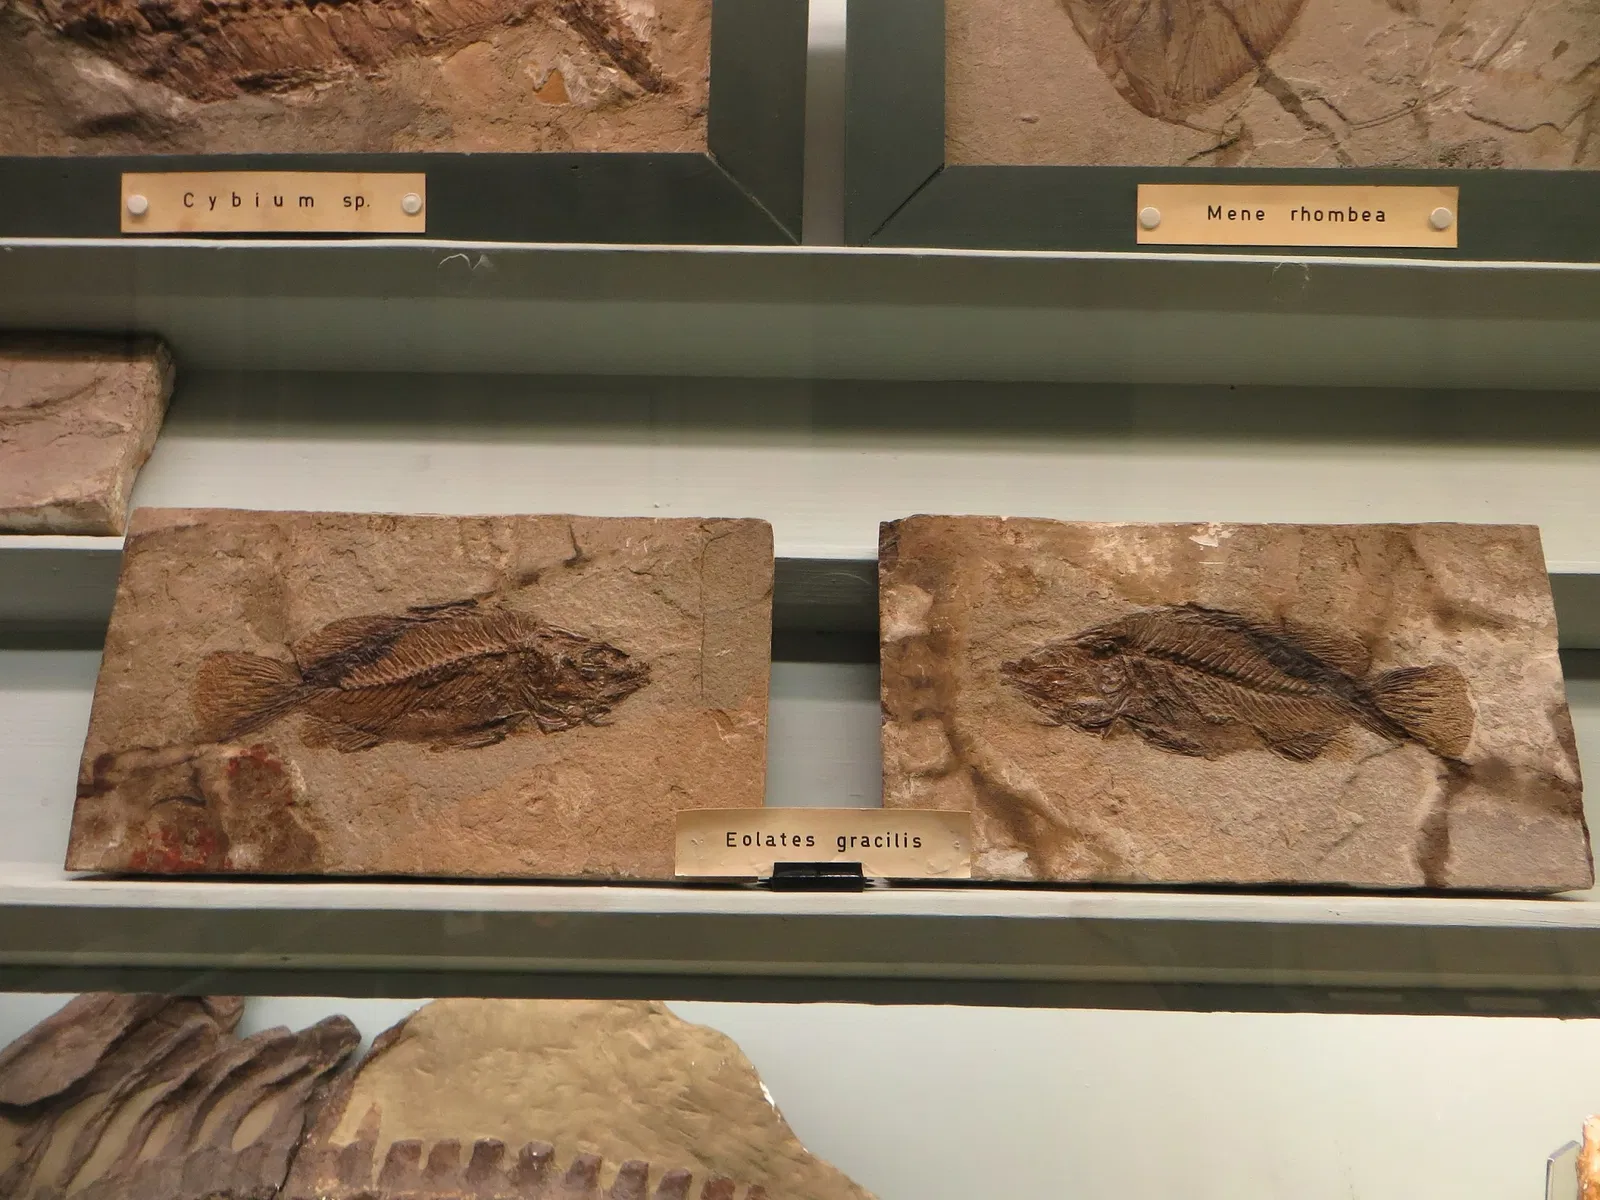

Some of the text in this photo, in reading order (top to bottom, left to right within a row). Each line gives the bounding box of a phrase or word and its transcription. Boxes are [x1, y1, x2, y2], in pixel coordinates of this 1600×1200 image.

[183, 191, 371, 212] Cybium sp.
[1207, 205, 1387, 223] Mene rhombea
[726, 831, 923, 853] Eolates gracilis
